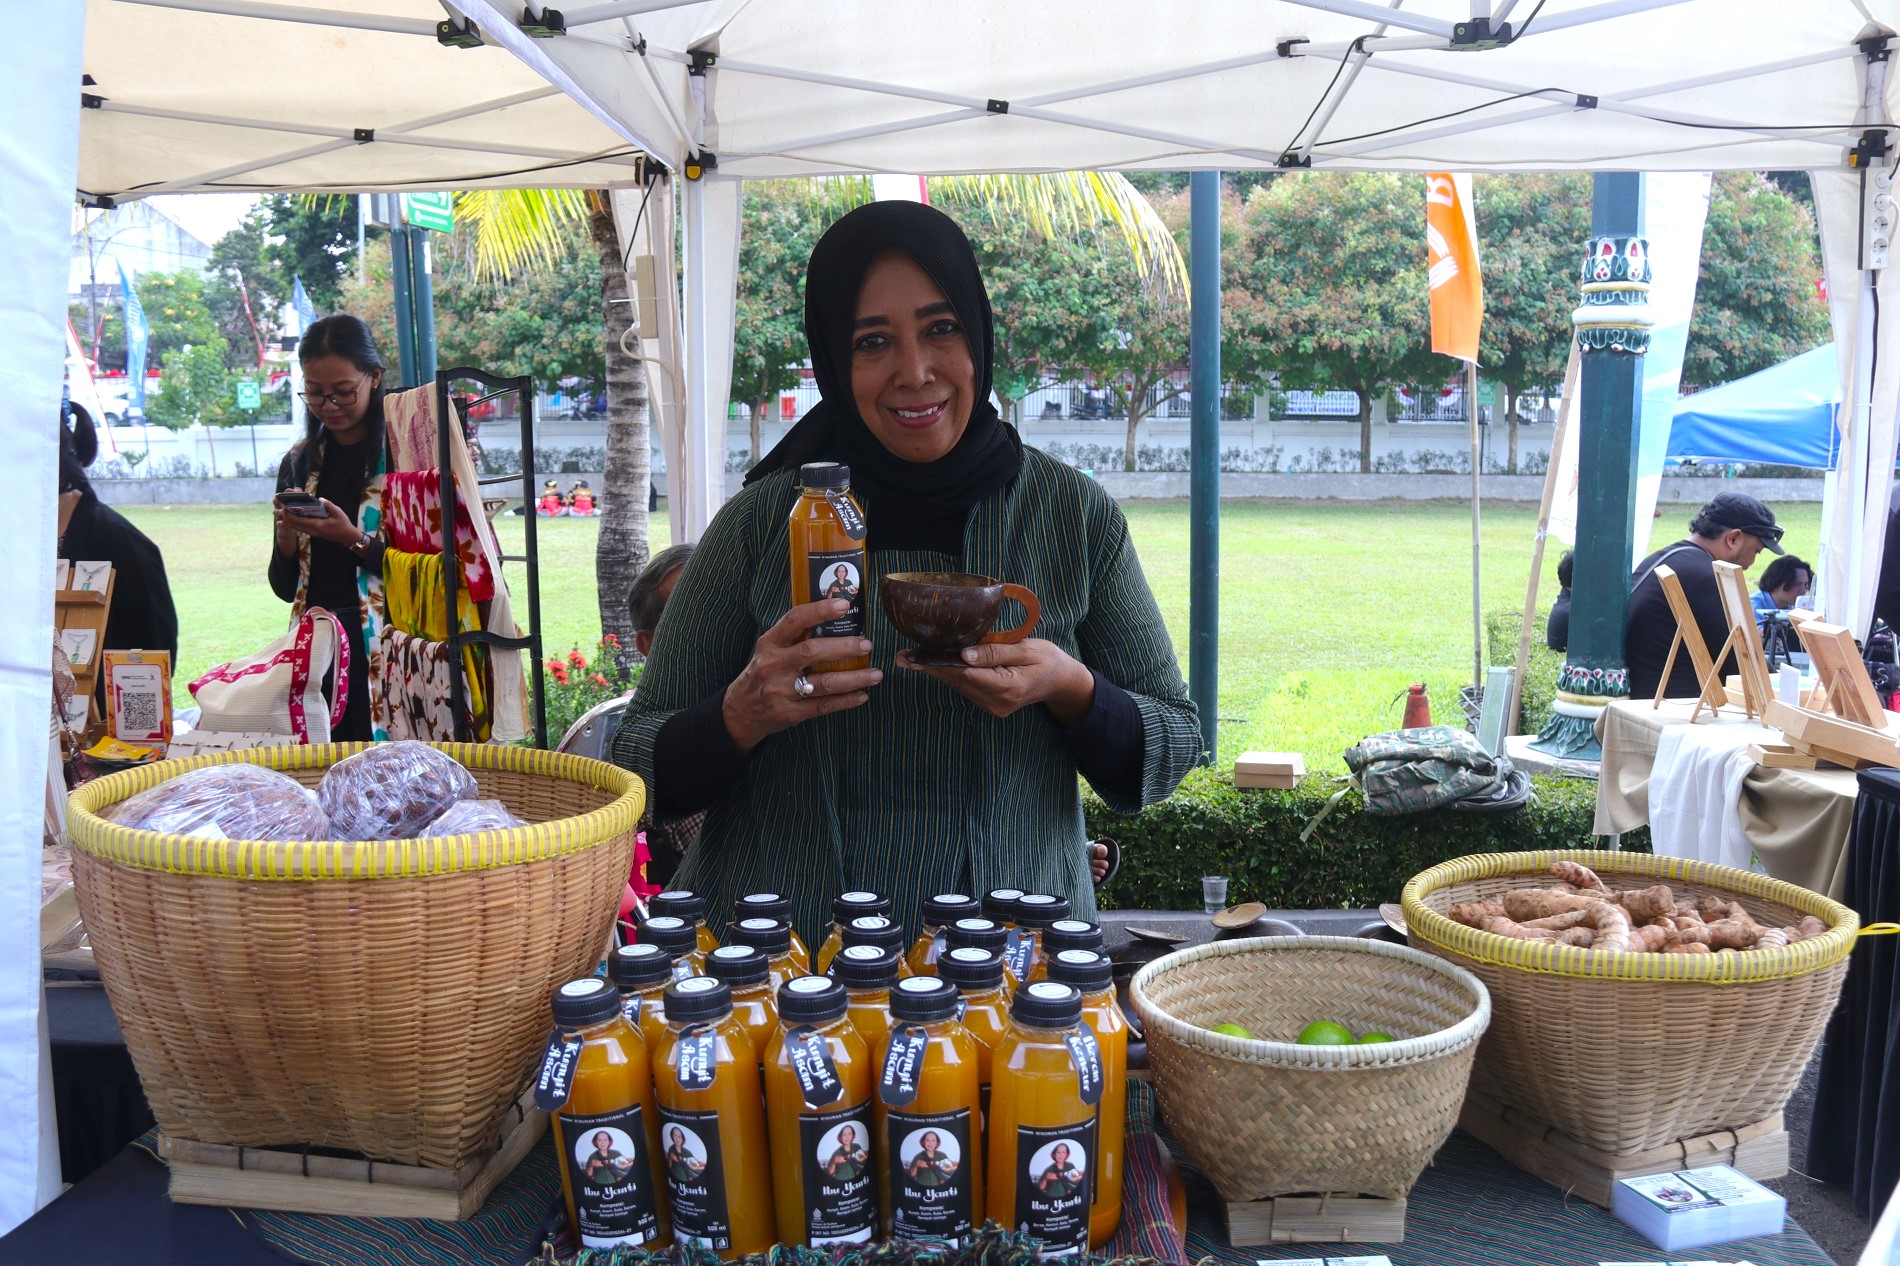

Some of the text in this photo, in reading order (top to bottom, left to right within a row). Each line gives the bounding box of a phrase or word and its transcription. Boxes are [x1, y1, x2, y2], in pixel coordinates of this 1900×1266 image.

[833, 502, 852, 530] Asam
[840, 494, 864, 532] Kunyit
[539, 1043, 561, 1090] Asam
[552, 1042, 580, 1098] Kunyit
[680, 1041, 695, 1080] Asam
[690, 1036, 713, 1082] Kunyit
[791, 1047, 814, 1091] Asam
[806, 1036, 836, 1090] Kunyit
[884, 1038, 905, 1085] Asam
[897, 1037, 924, 1093] Kunyit
[1069, 1036, 1090, 1092] Kencur
[584, 1182, 636, 1200] Ibu Yanti
[678, 1183, 707, 1196] Yanti
[823, 1176, 870, 1196] Ibu Yanti
[904, 1186, 958, 1202] Ibu Yanti
[1032, 1196, 1082, 1213] Ibu Yanti
